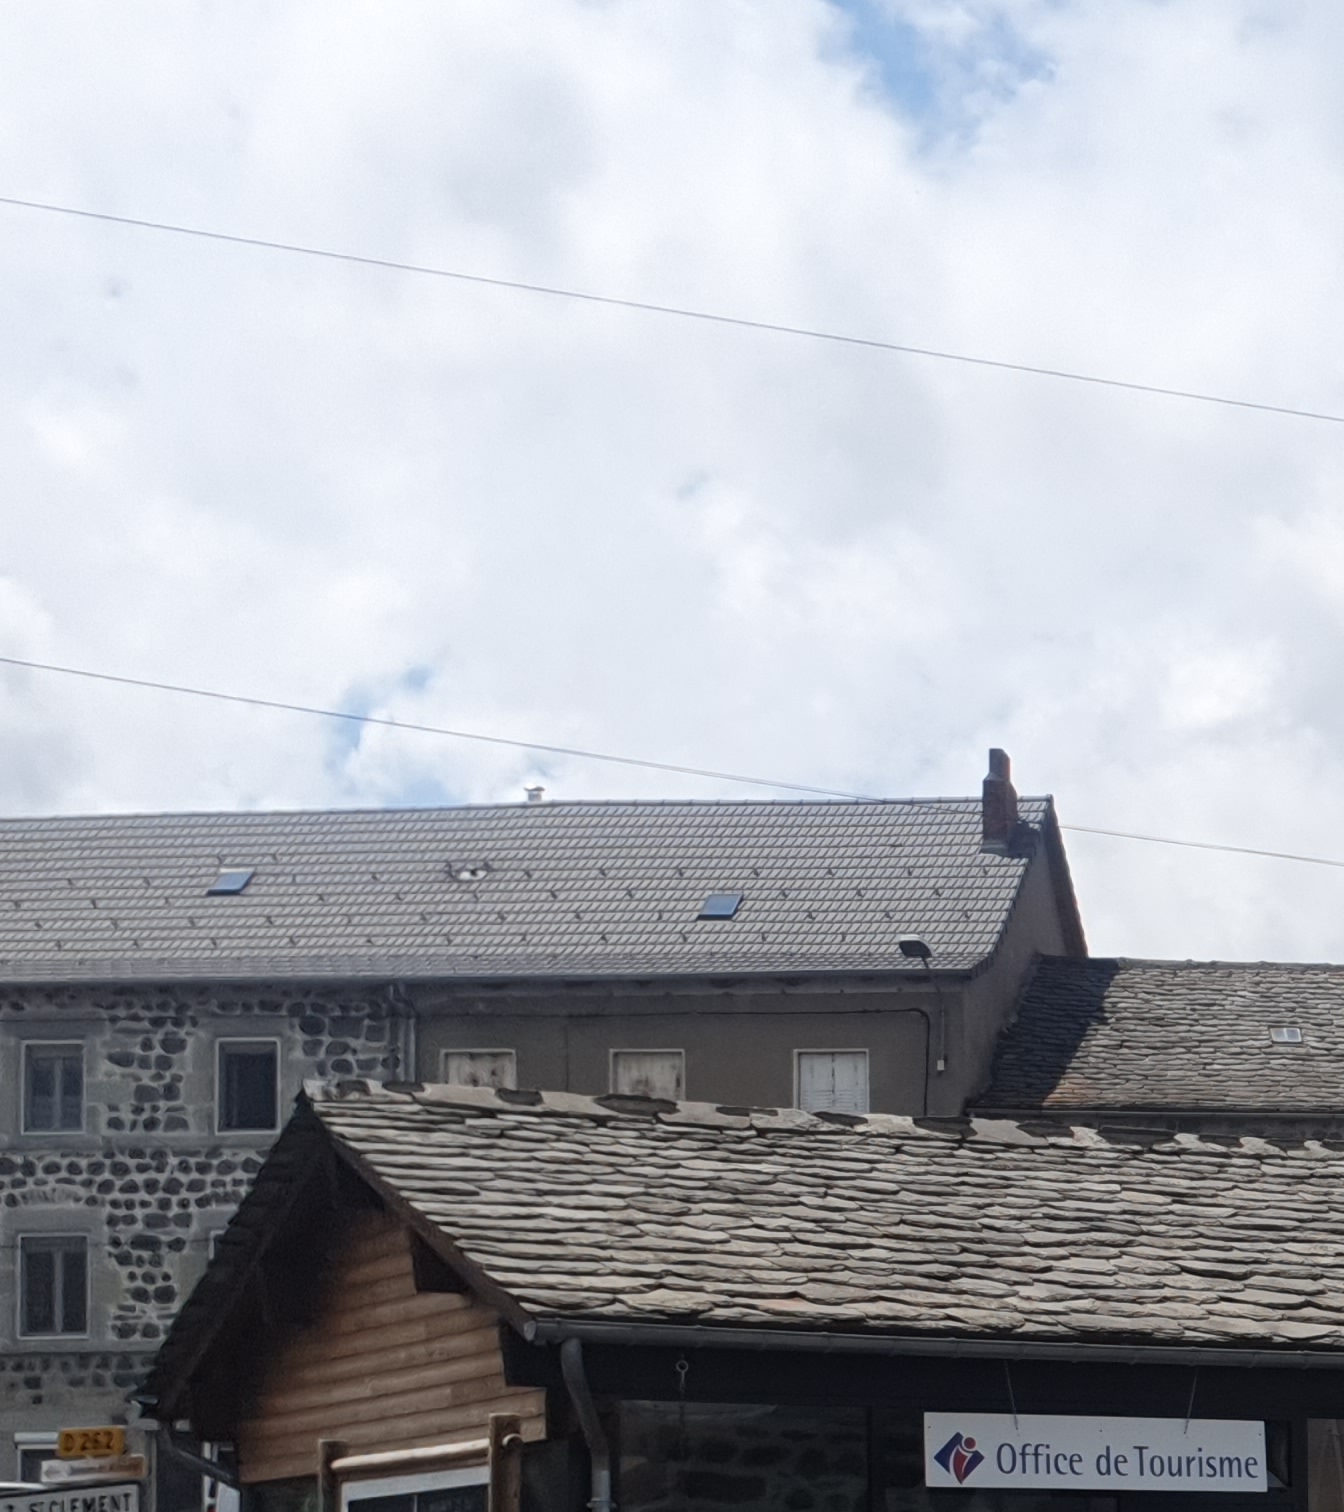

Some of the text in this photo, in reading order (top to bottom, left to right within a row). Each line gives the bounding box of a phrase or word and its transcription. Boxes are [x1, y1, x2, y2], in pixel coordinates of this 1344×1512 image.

[63, 1433, 75, 1453] D
[996, 1442, 1258, 1478] Office de Tourisme
